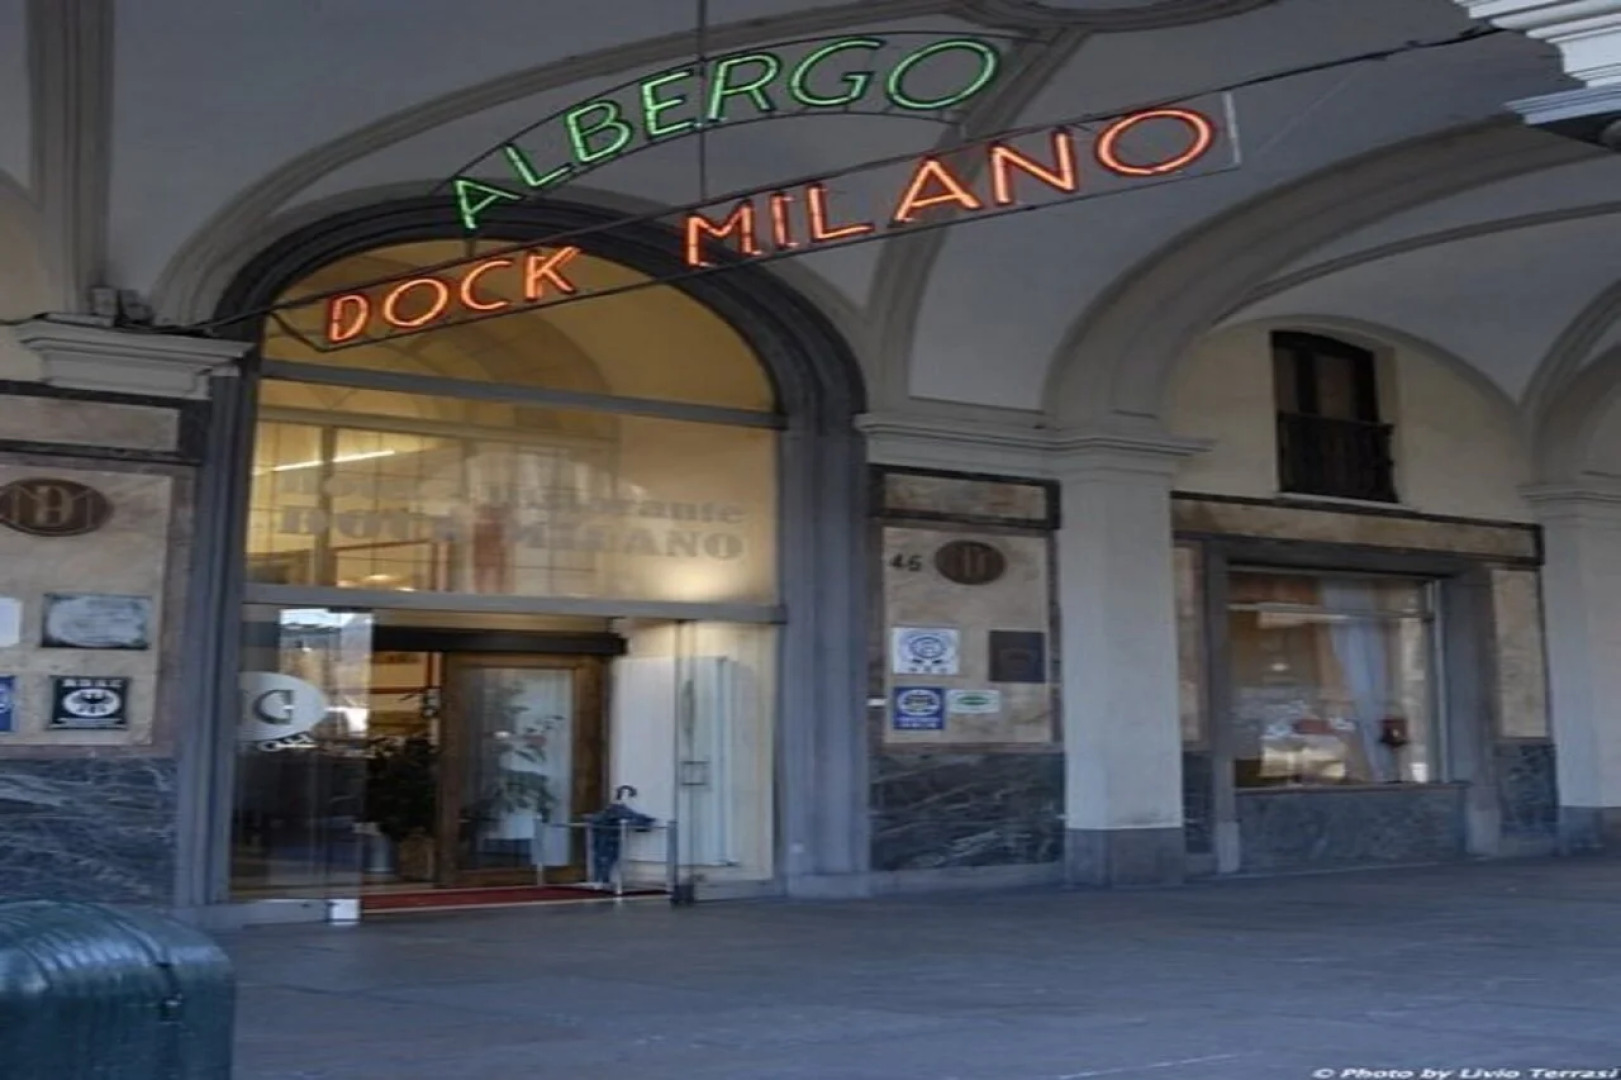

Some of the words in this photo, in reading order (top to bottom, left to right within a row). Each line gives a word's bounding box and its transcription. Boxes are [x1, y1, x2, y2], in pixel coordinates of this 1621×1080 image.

[325, 245, 580, 346] DOCK
[683, 104, 1216, 270] MILANO
[451, 35, 1002, 231] ALBERGO
